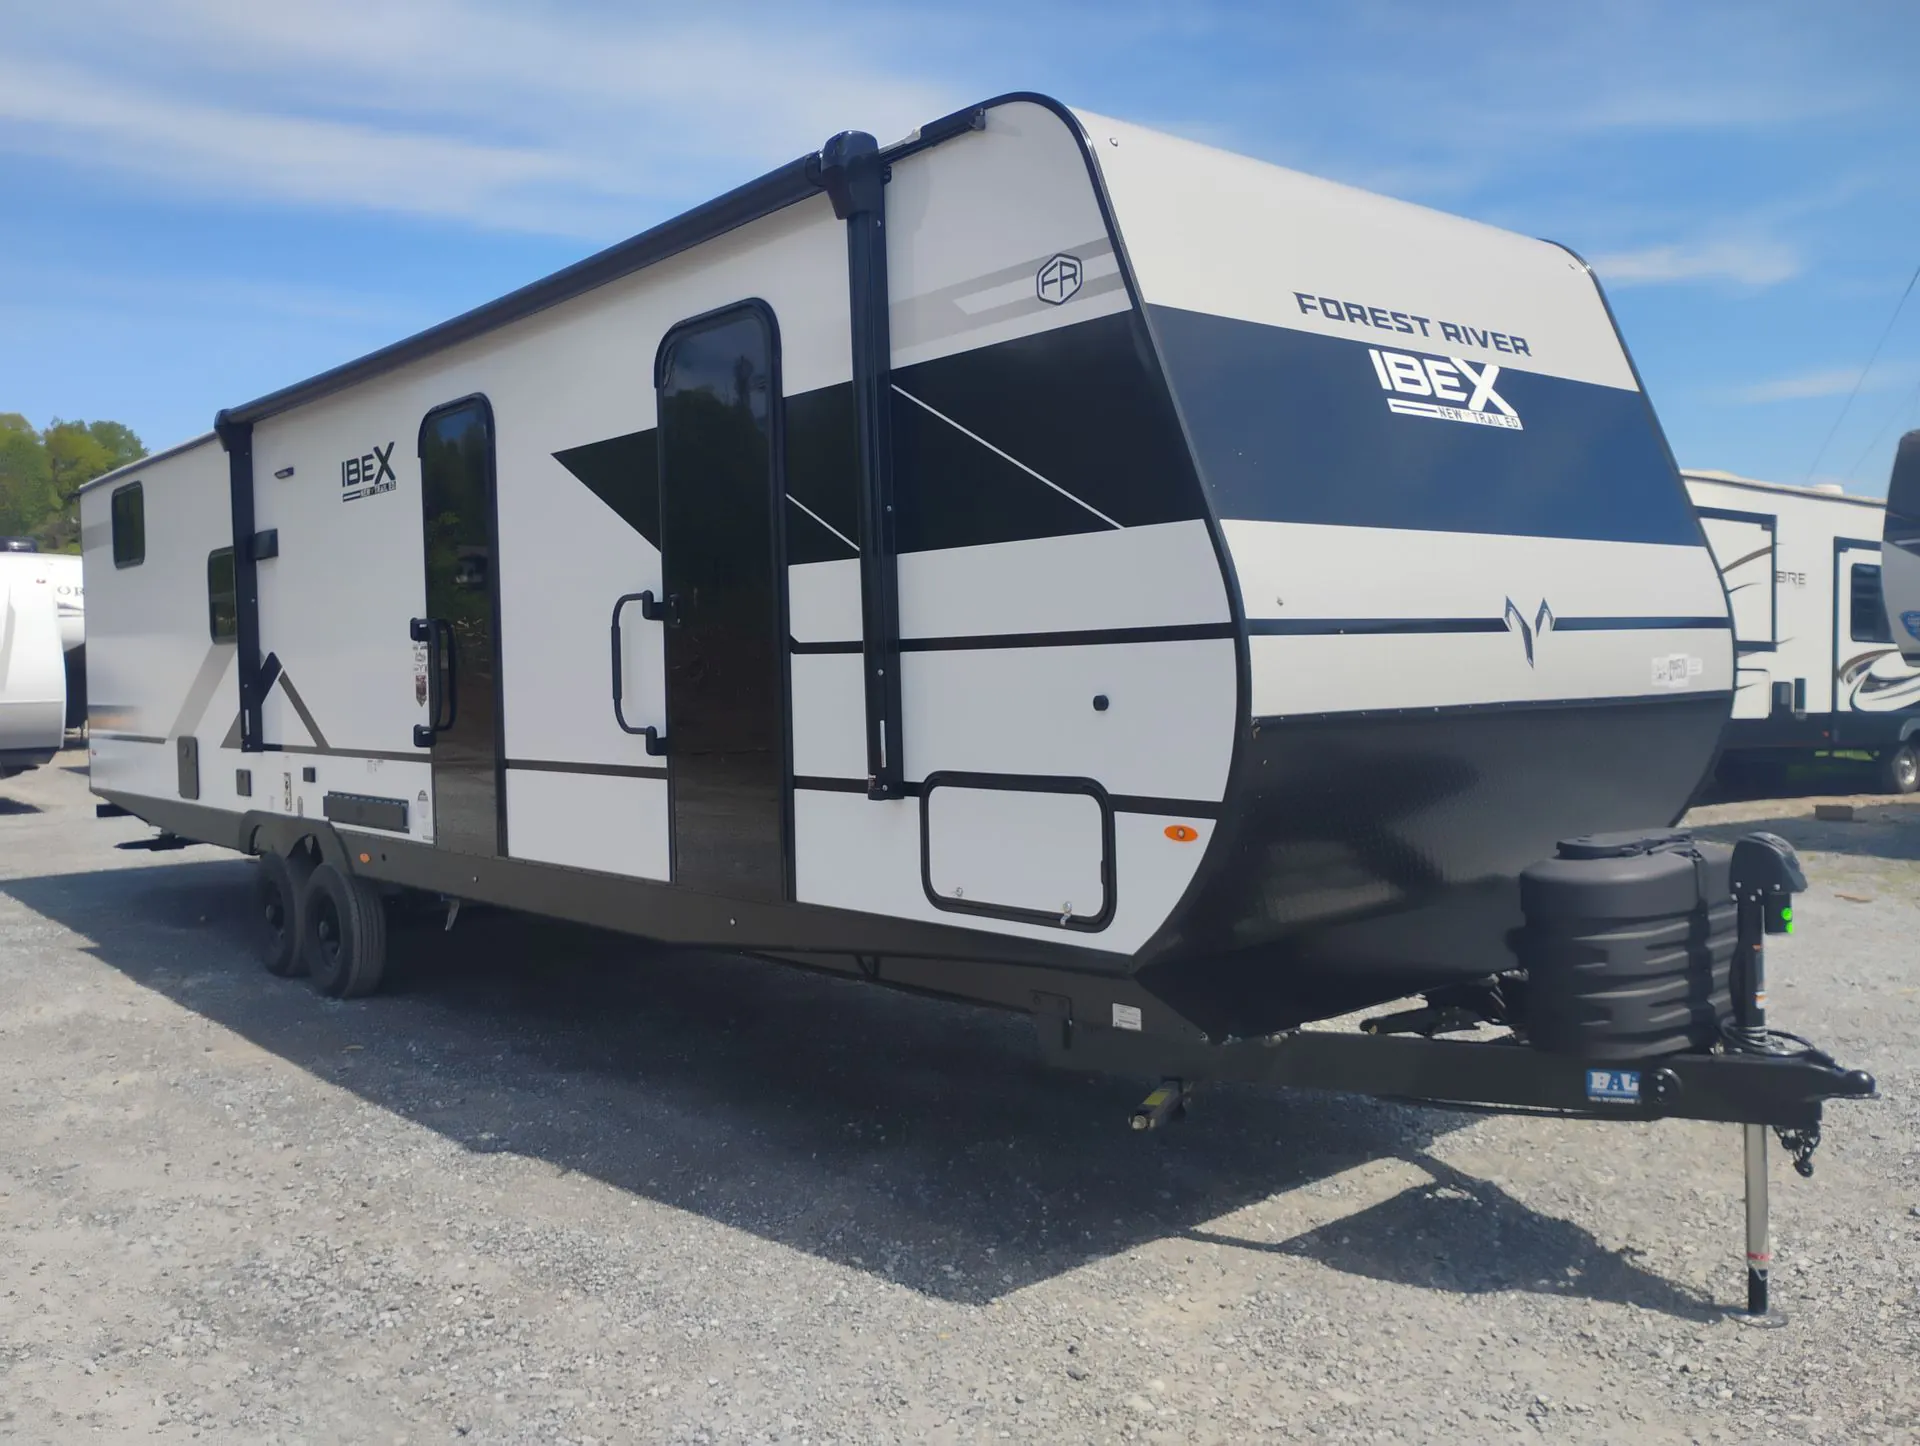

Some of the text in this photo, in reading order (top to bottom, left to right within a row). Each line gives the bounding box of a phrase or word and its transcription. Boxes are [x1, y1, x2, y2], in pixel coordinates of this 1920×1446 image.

[1292, 291, 1532, 357] FOREST RIVER
[1368, 348, 1519, 418] IBEX
[1438, 406, 1462, 420] NEW
[1471, 412, 1504, 426] TRAIL
[341, 440, 396, 488] IBEX
